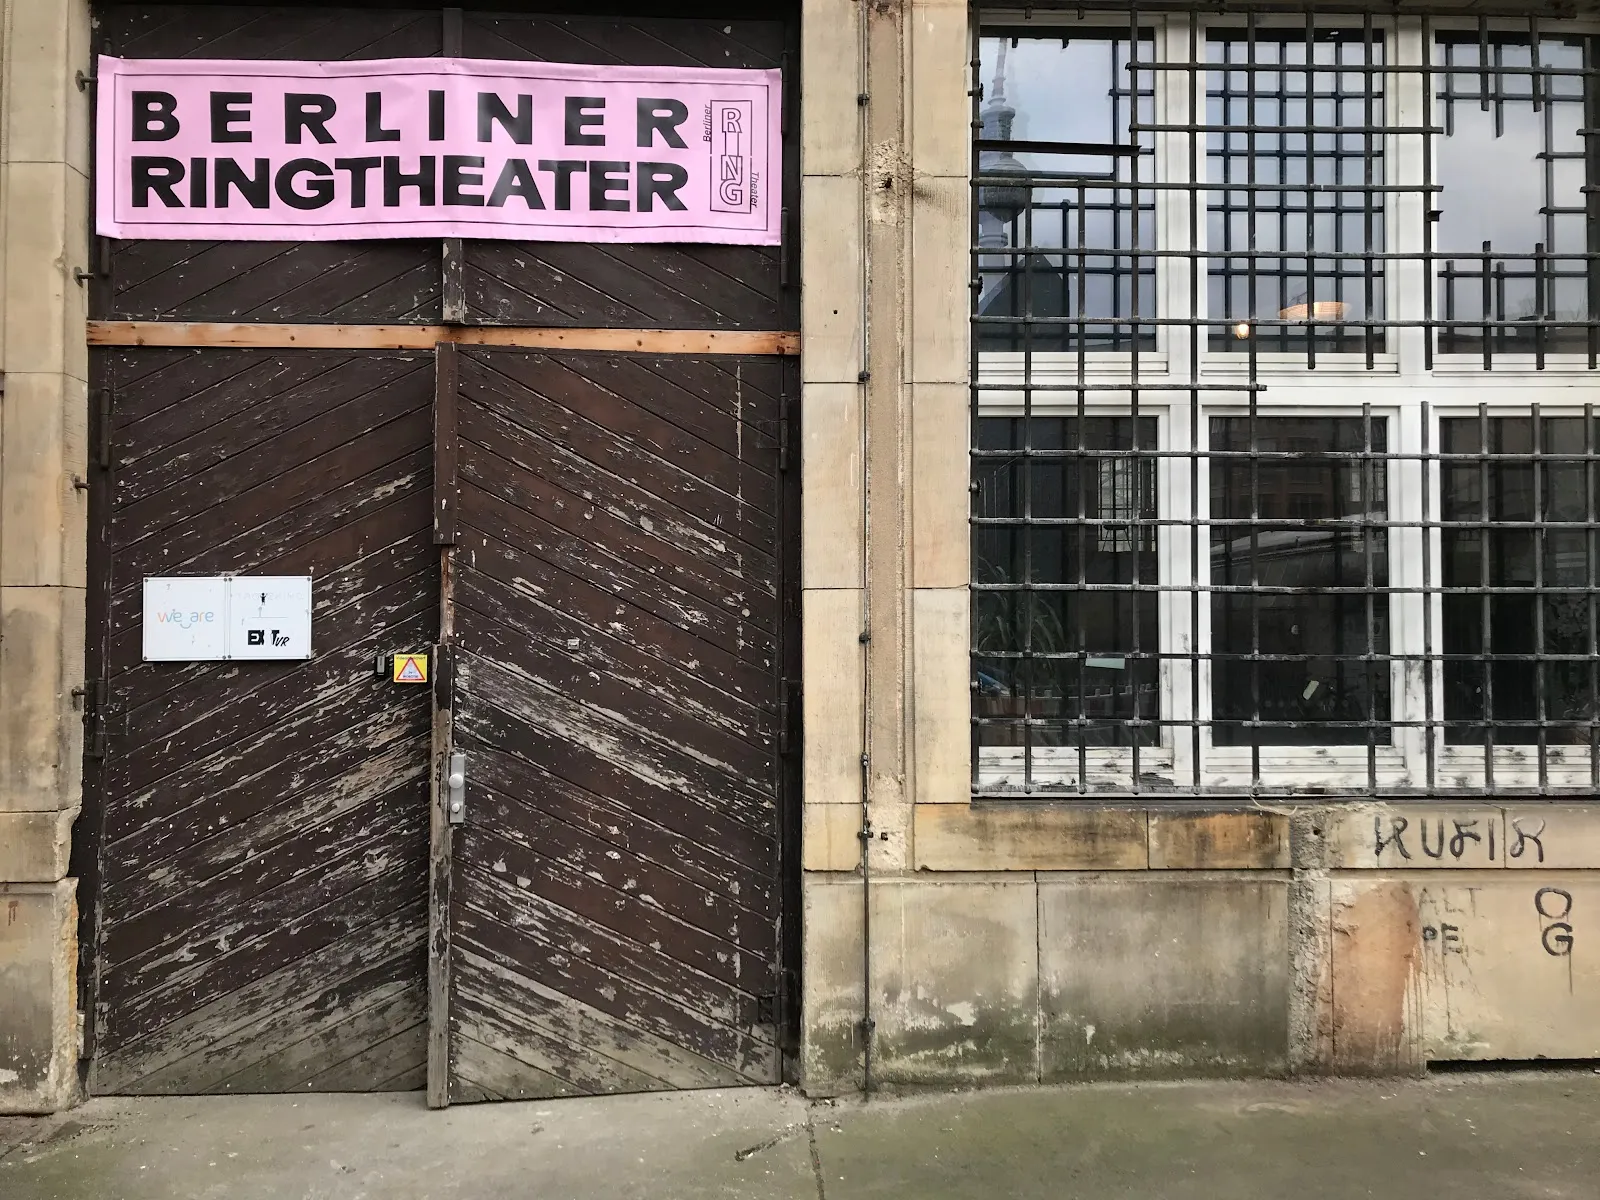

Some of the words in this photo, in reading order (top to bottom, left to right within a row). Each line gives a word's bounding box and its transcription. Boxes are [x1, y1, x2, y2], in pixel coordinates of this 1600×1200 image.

[131, 90, 689, 149] BERLINER
[703, 104, 712, 142] Berliner
[719, 107, 743, 205] RING
[131, 155, 689, 212] RINGTHEATER
[750, 172, 760, 208] Theater
[157, 611, 182, 623] we
[190, 611, 214, 623] are
